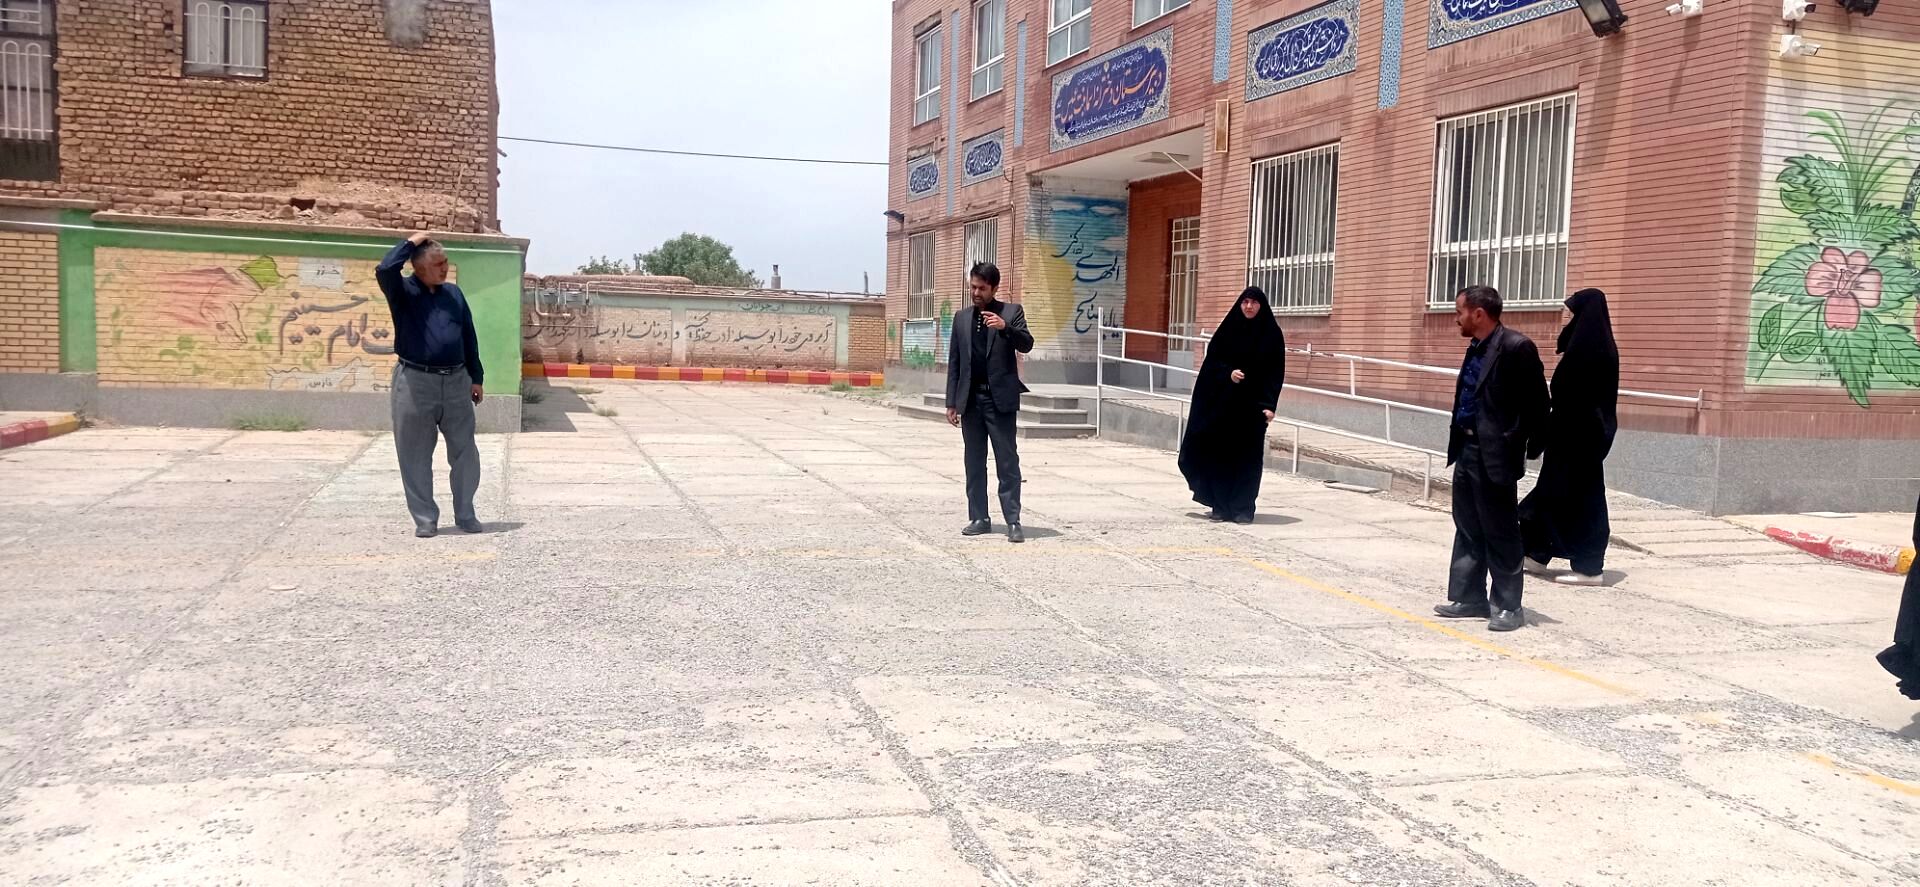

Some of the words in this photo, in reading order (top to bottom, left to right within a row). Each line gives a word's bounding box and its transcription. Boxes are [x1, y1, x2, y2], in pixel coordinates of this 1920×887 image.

[1112, 63, 1162, 106] دبیرستان
[316, 265, 340, 276] خزر
[674, 330, 680, 340] و
